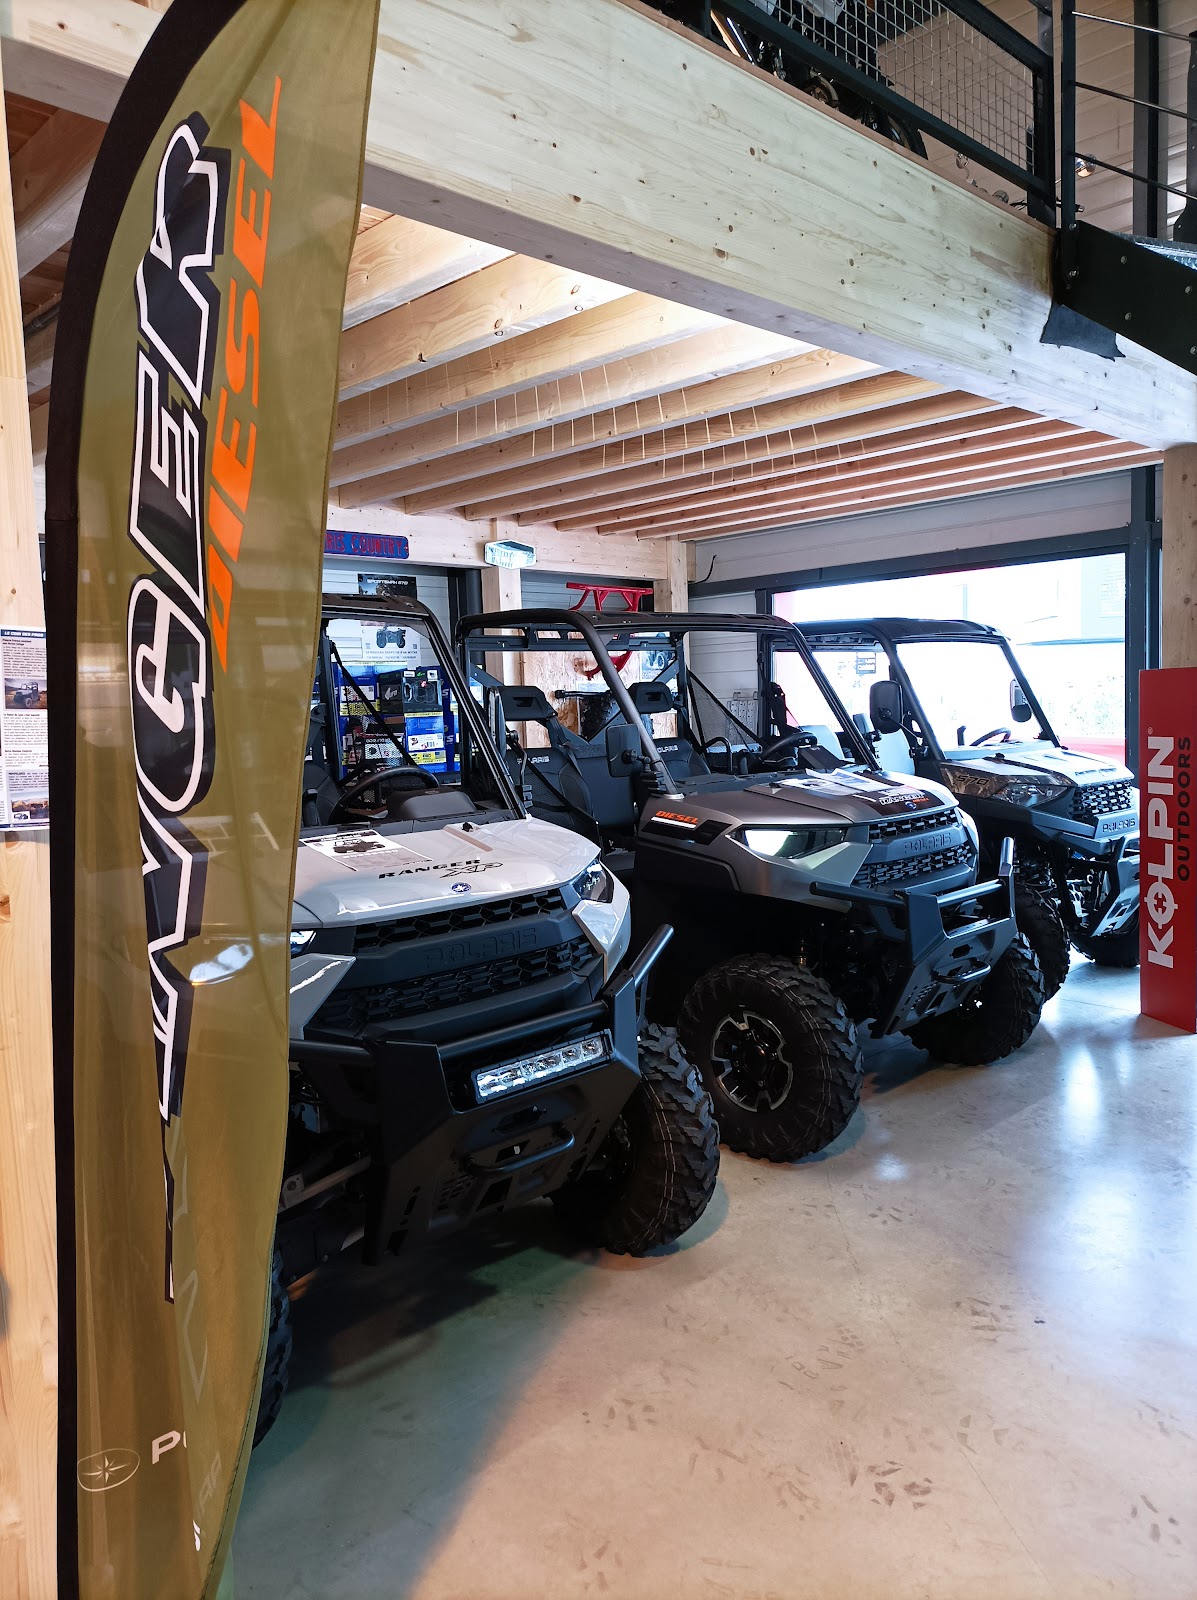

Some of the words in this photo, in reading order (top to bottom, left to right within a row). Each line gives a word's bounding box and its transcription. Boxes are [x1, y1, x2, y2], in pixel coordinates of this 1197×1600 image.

[208, 75, 282, 673] DIESEL
[325, 533, 346, 552] RIS
[351, 534, 403, 556] COUNTRY
[657, 744, 679, 753] OLARIS
[956, 774, 990, 786] 570
[655, 810, 699, 824] DIESEL
[1177, 736, 1191, 882] OUTDOORS
[1102, 818, 1136, 833] POLARIS
[904, 832, 952, 855] POLARIS
[1146, 736, 1178, 969] KOLPIN
[378, 859, 481, 879] RANGER
[439, 862, 504, 878] XP
[423, 927, 537, 969] POLARIS
